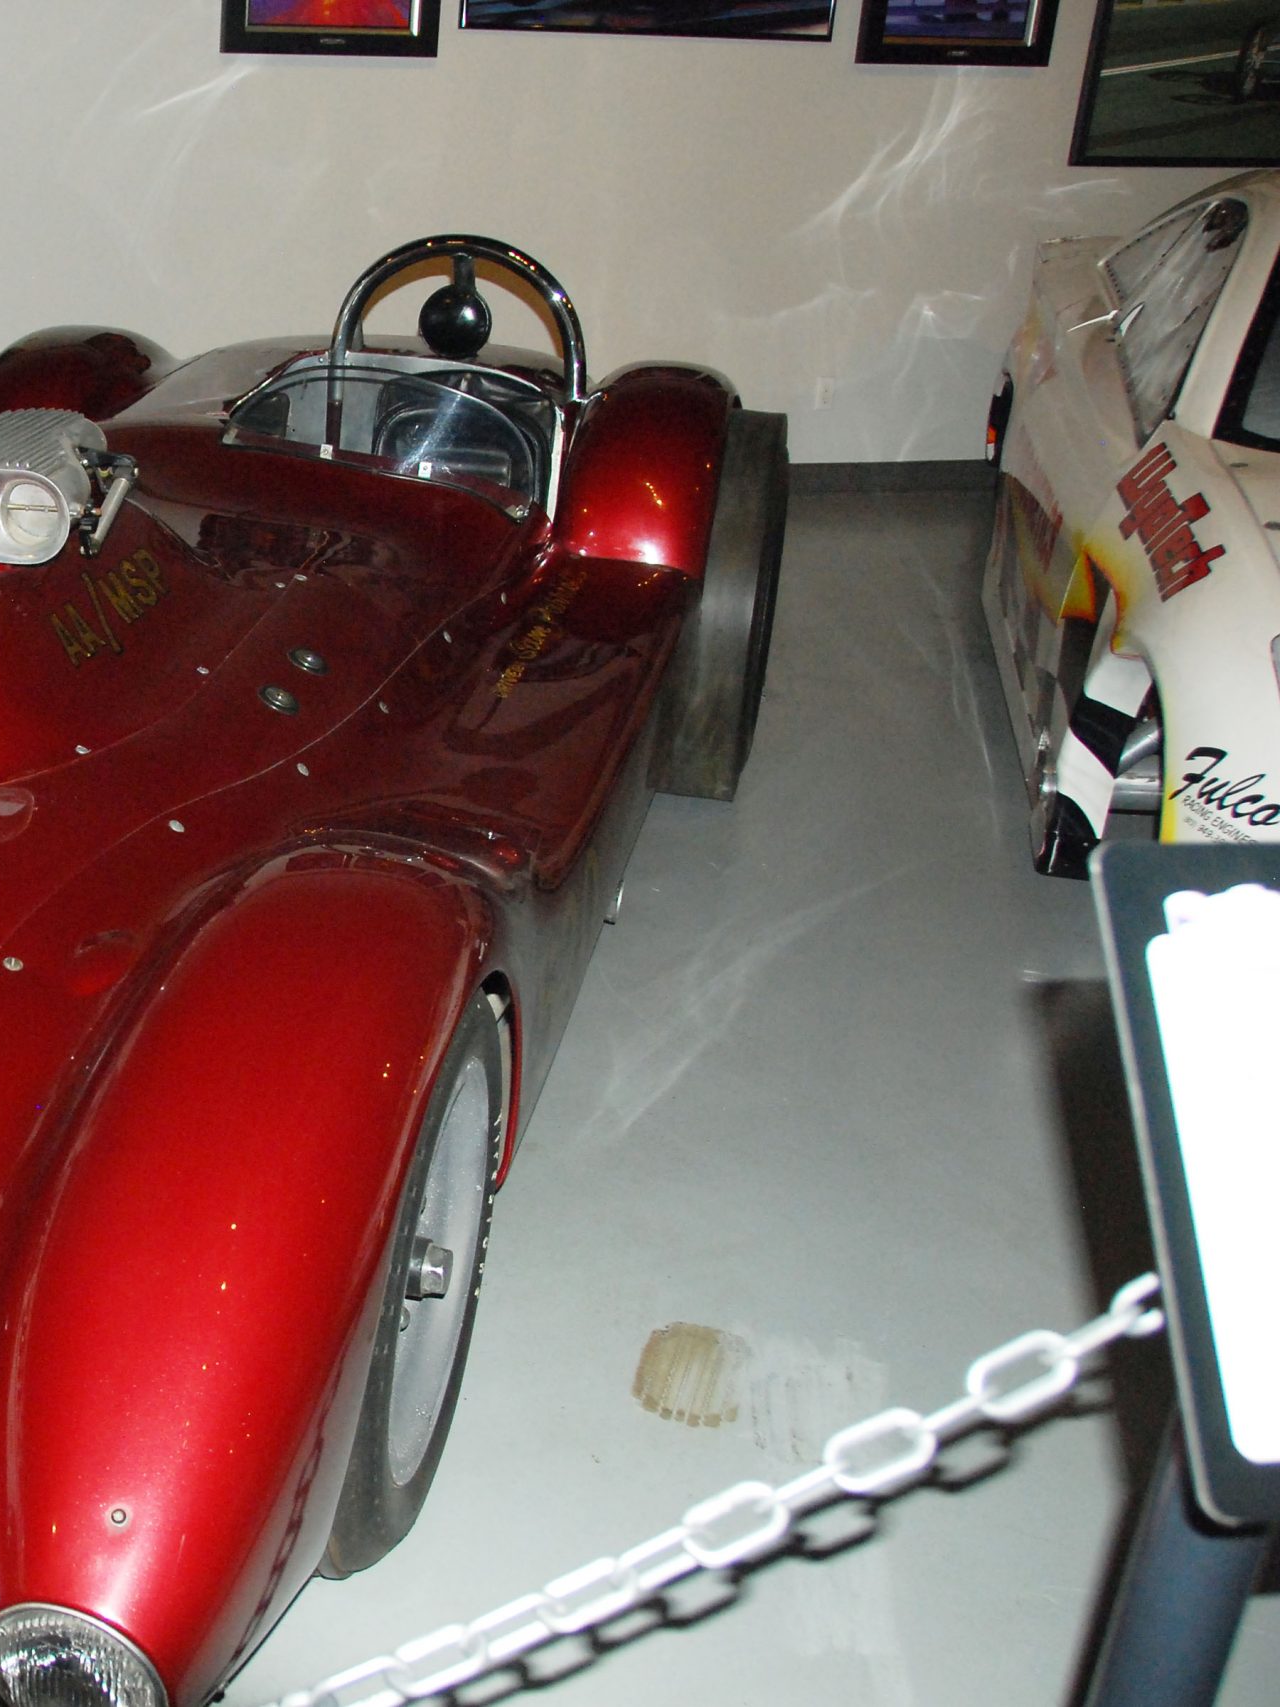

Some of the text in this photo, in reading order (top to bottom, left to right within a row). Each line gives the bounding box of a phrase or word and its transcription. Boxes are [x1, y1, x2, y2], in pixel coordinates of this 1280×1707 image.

[50, 549, 170, 667] AA/MSP
[1167, 746, 1280, 826] Fulco
[1183, 794, 1214, 821] RACING
